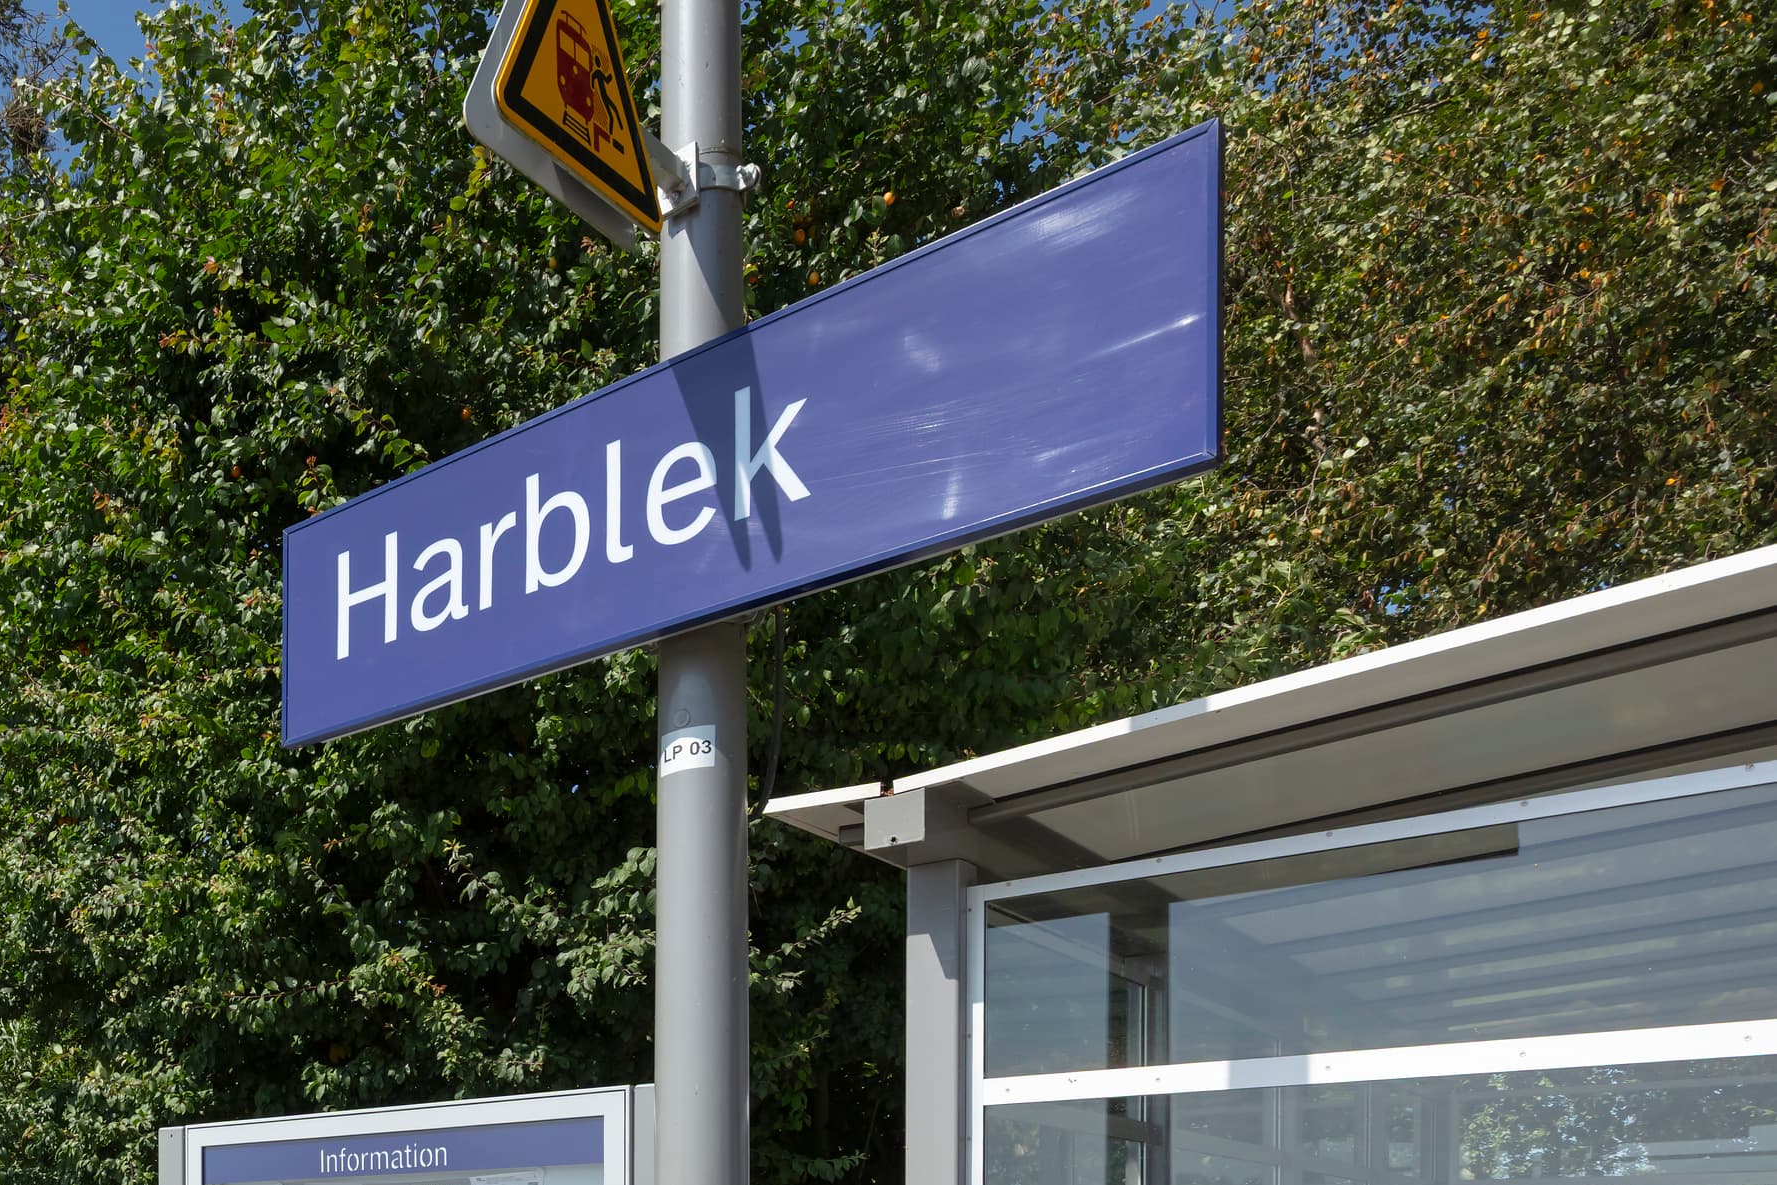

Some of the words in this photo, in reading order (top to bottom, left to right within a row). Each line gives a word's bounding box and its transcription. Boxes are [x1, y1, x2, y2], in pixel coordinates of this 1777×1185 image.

[335, 385, 812, 660] Harblek
[663, 744, 683, 763] LP
[689, 739, 712, 756] 03
[320, 1143, 447, 1173] Information
